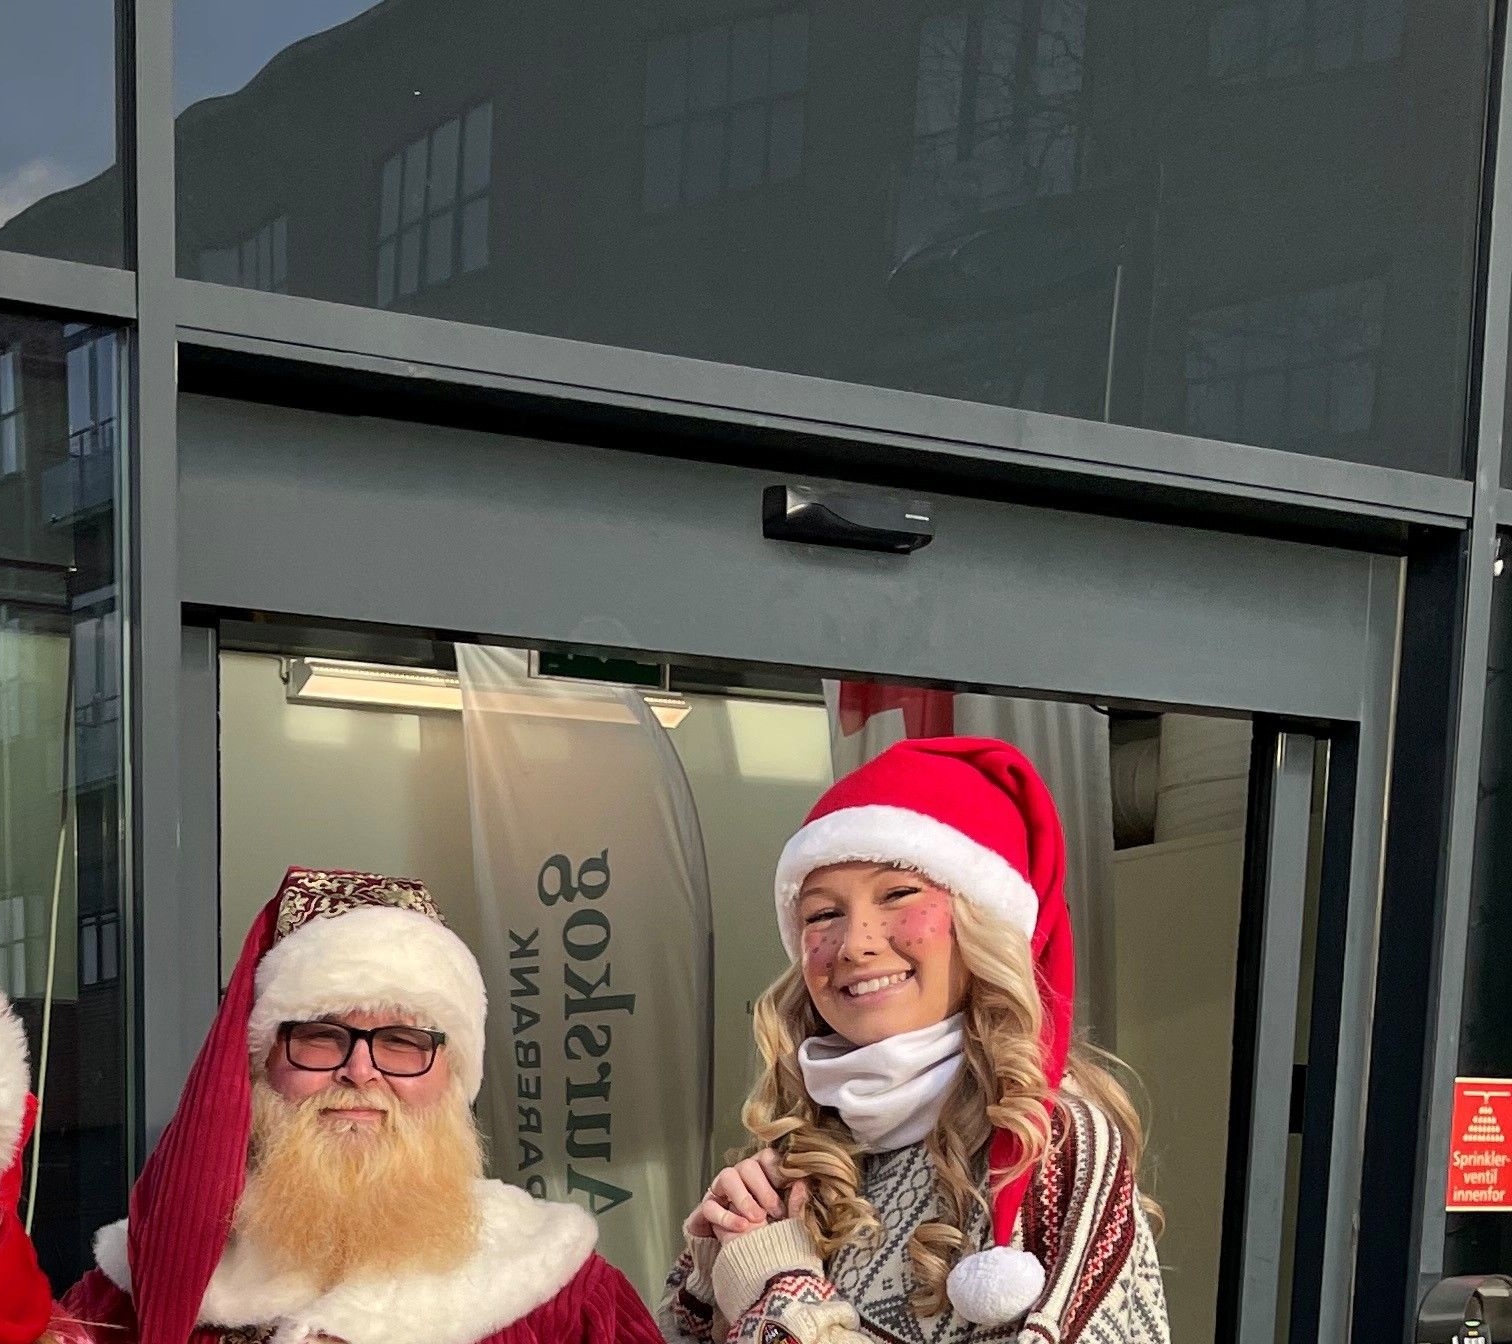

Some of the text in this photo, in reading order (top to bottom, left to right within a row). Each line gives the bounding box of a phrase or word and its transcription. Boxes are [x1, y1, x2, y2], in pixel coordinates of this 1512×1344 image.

[1453, 1150, 1512, 1169] Sprinkler-
[1464, 1169, 1497, 1184] ventil
[1453, 1187, 1506, 1202] innenfor
